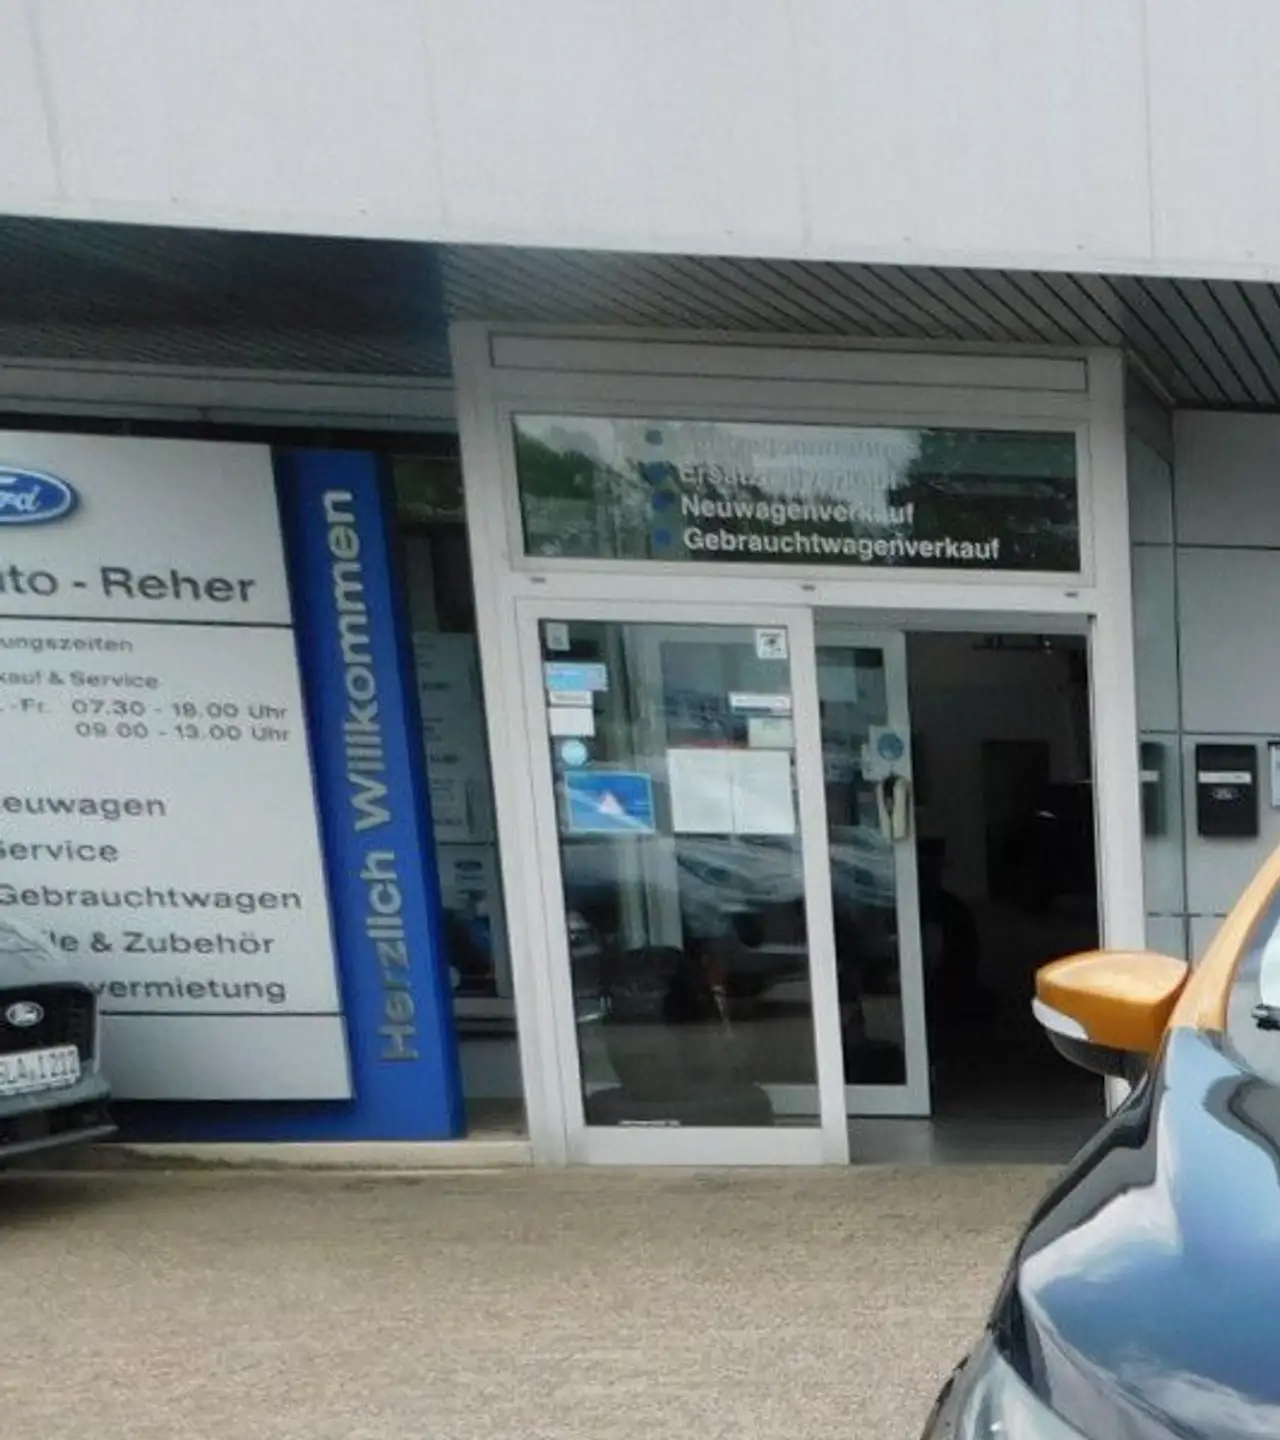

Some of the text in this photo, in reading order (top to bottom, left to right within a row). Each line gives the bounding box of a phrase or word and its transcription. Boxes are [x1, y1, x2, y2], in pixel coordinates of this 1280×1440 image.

[681, 494, 915, 525] Neuwagenverkauf
[683, 527, 1001, 561] Gebrauchtwagenverkauf
[0, 564, 58, 597] to
[101, 565, 256, 602] Reher
[49, 671, 65, 686] &
[70, 671, 159, 689] Service
[72, 699, 146, 717] 07.30
[250, 705, 289, 721] Uhr
[252, 727, 291, 742] Uhr
[322, 488, 419, 1061] Herzlich Willkommen
[90, 931, 112, 952] &
[122, 930, 276, 955] Zubehör
